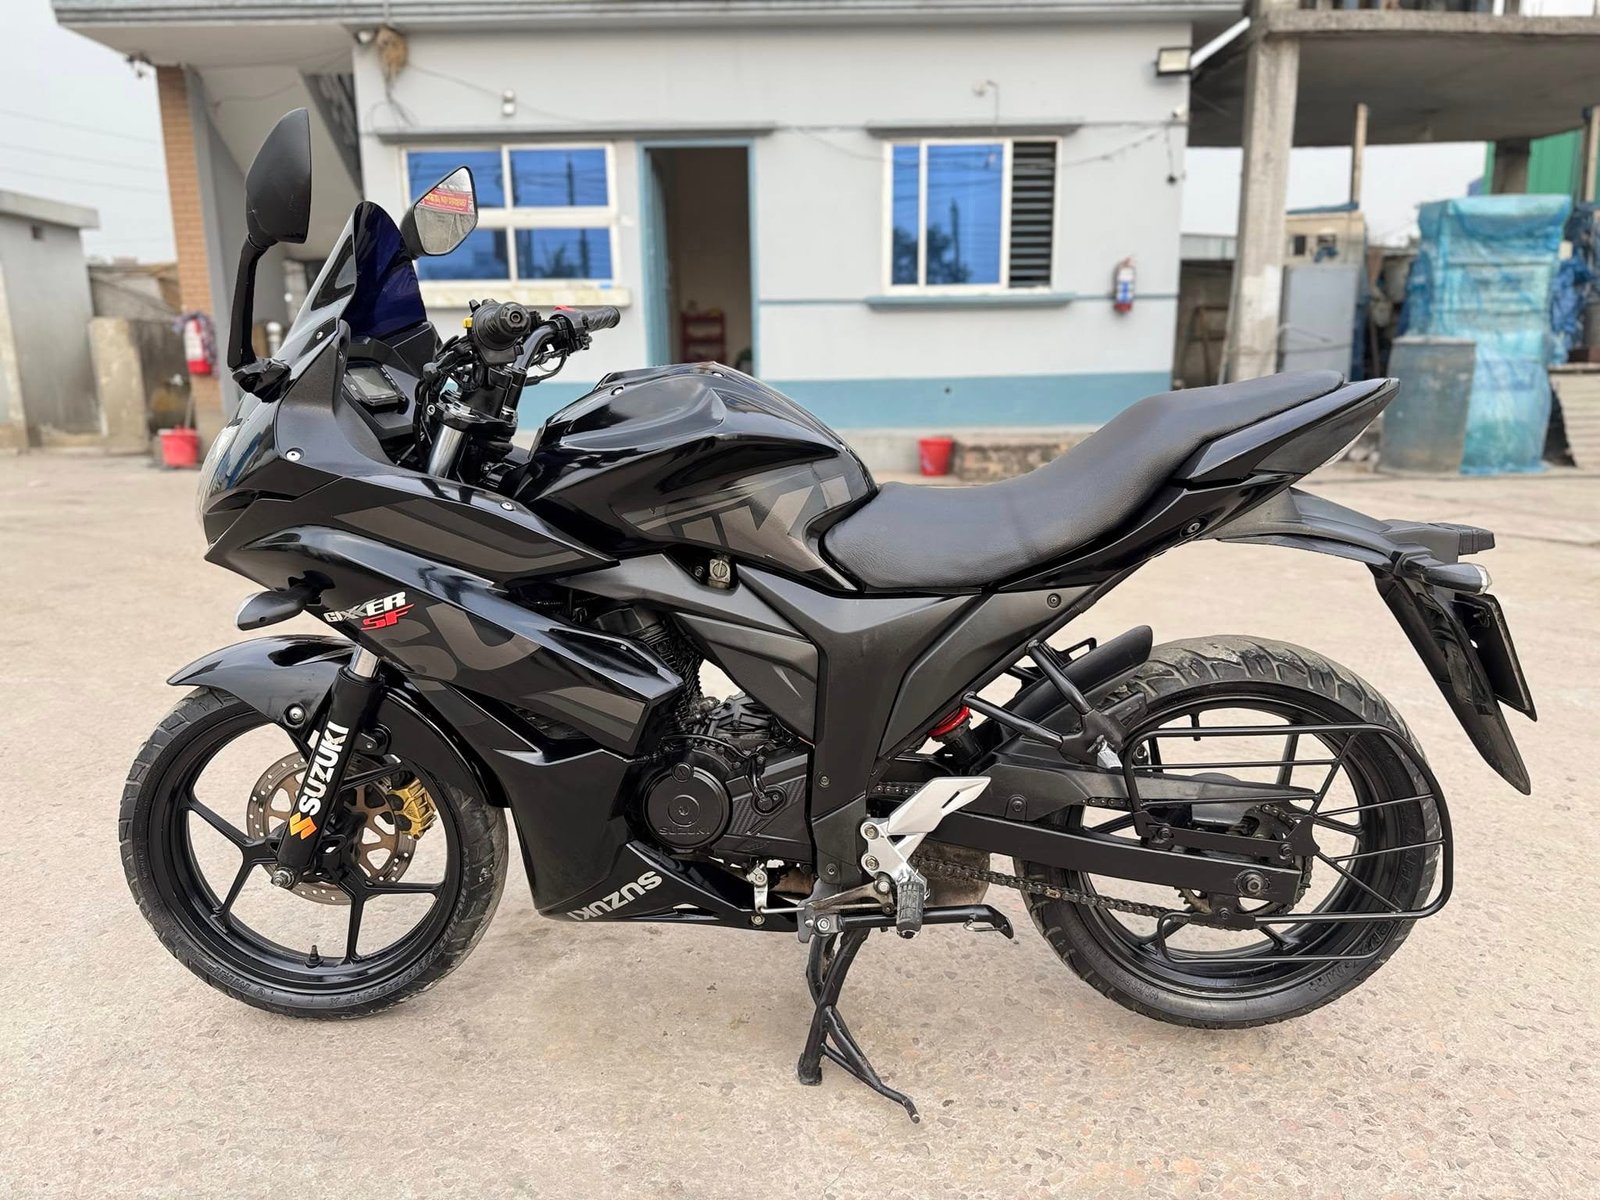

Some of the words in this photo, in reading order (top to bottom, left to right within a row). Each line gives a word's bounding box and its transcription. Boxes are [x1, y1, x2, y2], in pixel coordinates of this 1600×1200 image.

[323, 591, 406, 623] GIXXER
[360, 604, 415, 631] SF
[299, 720, 349, 816] SUZUKI
[566, 870, 663, 921] SUZUKI
